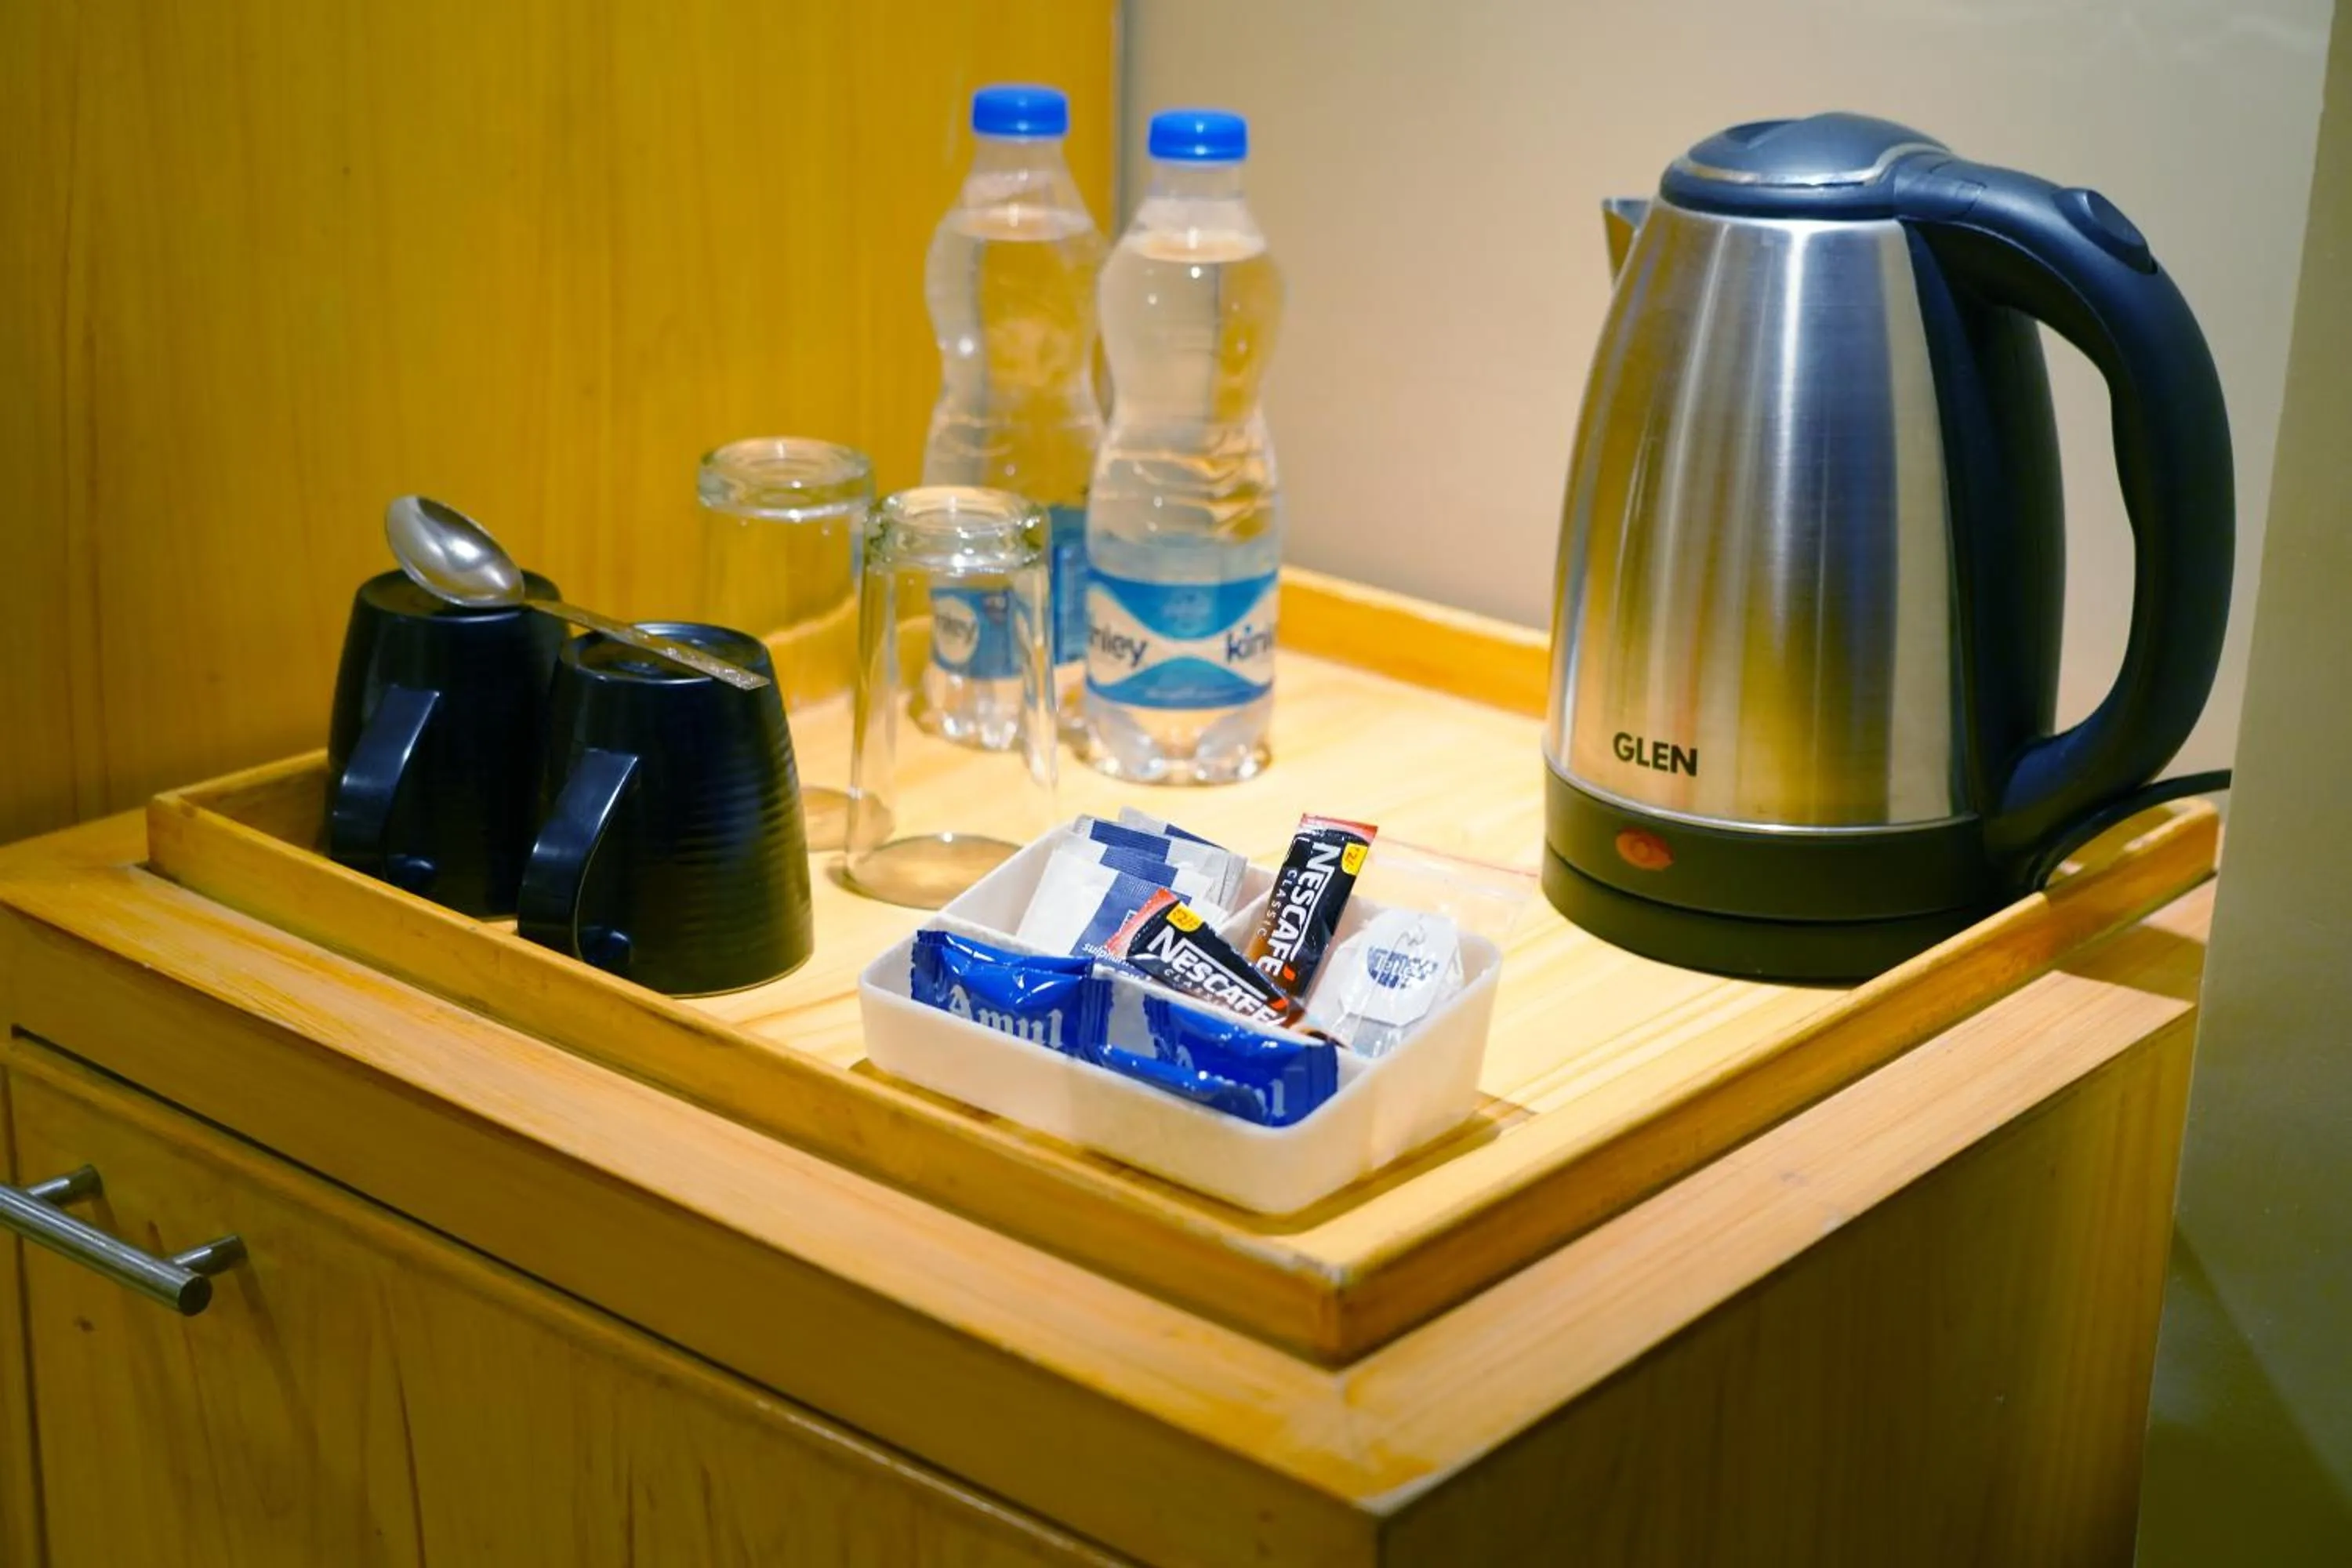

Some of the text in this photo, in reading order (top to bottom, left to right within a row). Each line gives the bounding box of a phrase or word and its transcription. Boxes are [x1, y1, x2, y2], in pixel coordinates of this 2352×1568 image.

[1613, 732, 1698, 776] GLEN
[1257, 869, 1298, 938] CLASSIC
[949, 984, 1064, 1048] Amul
